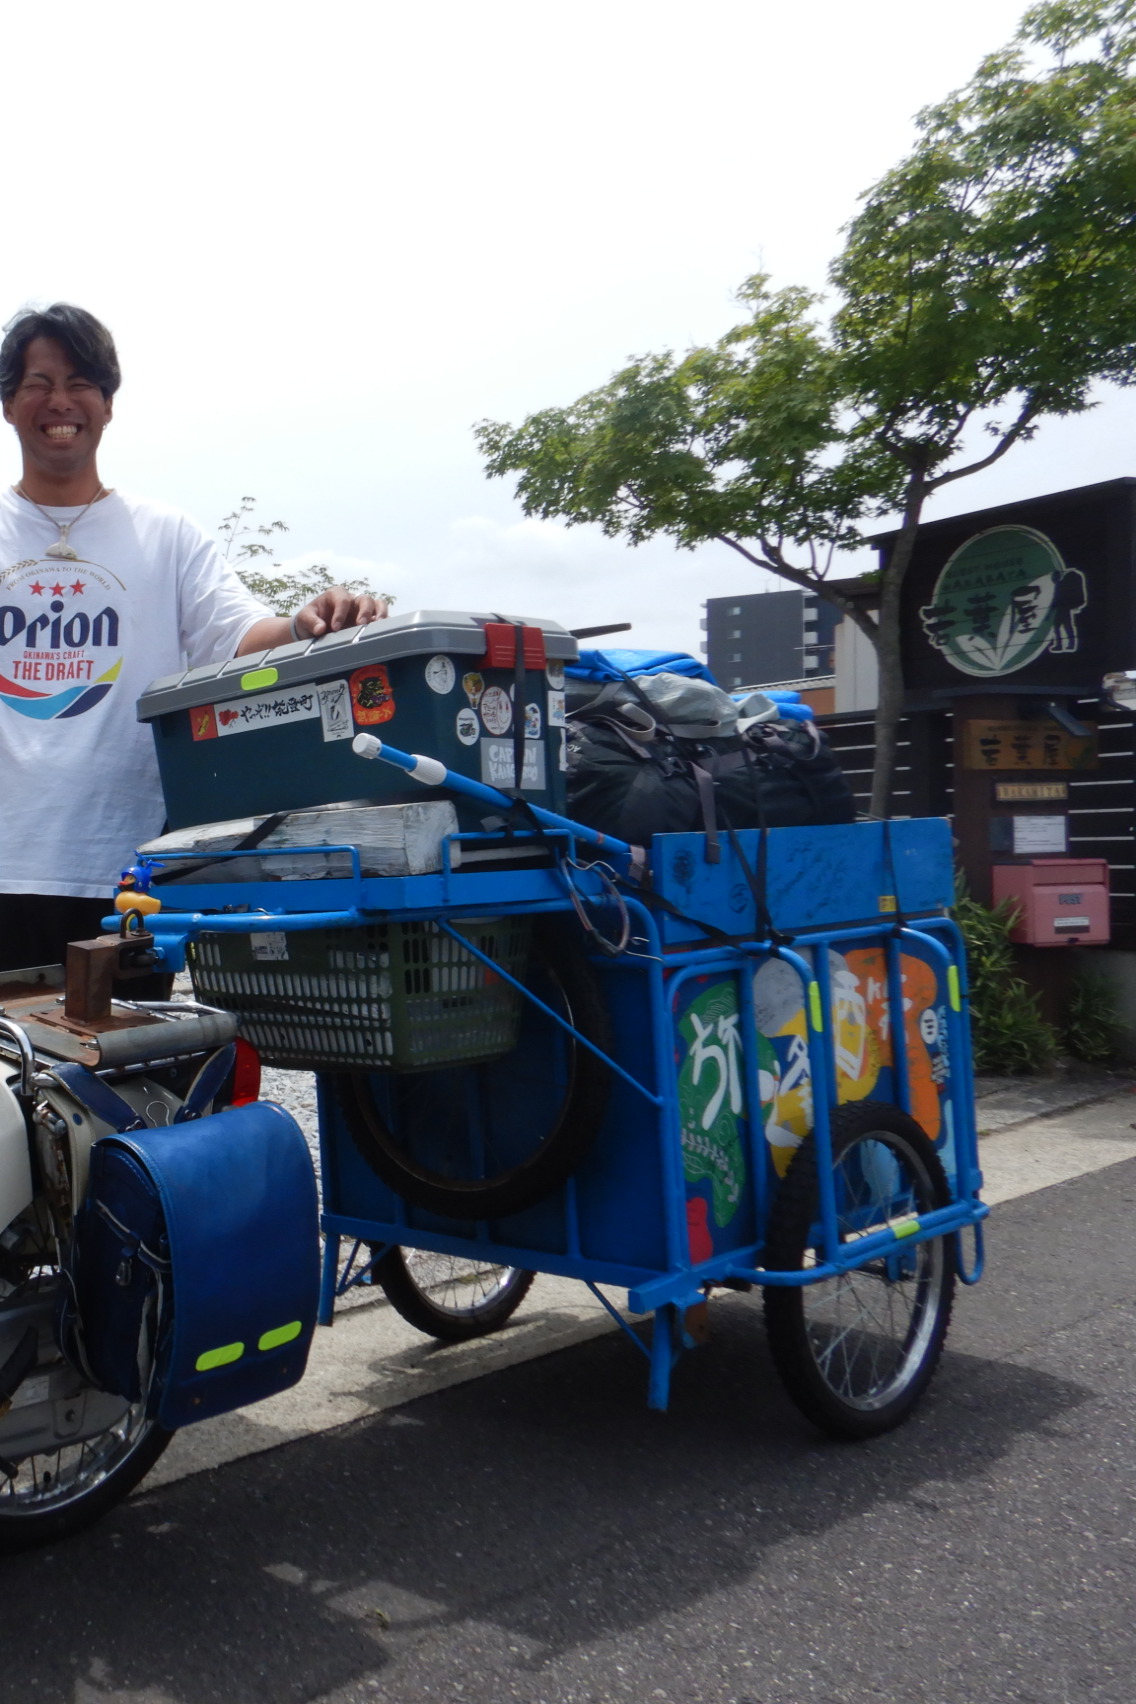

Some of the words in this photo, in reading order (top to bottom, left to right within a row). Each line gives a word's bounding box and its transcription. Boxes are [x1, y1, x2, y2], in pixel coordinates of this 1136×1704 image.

[6, 574, 25, 591] FROM
[25, 567, 60, 578] OKINAWA
[89, 571, 111, 591] WORLD
[923, 585, 1041, 646] 若葉屋
[23, 651, 61, 660] OKINAWA'S
[63, 650, 85, 660] CRAFT
[12, 660, 42, 681] THE
[45, 660, 95, 681] DRAFT
